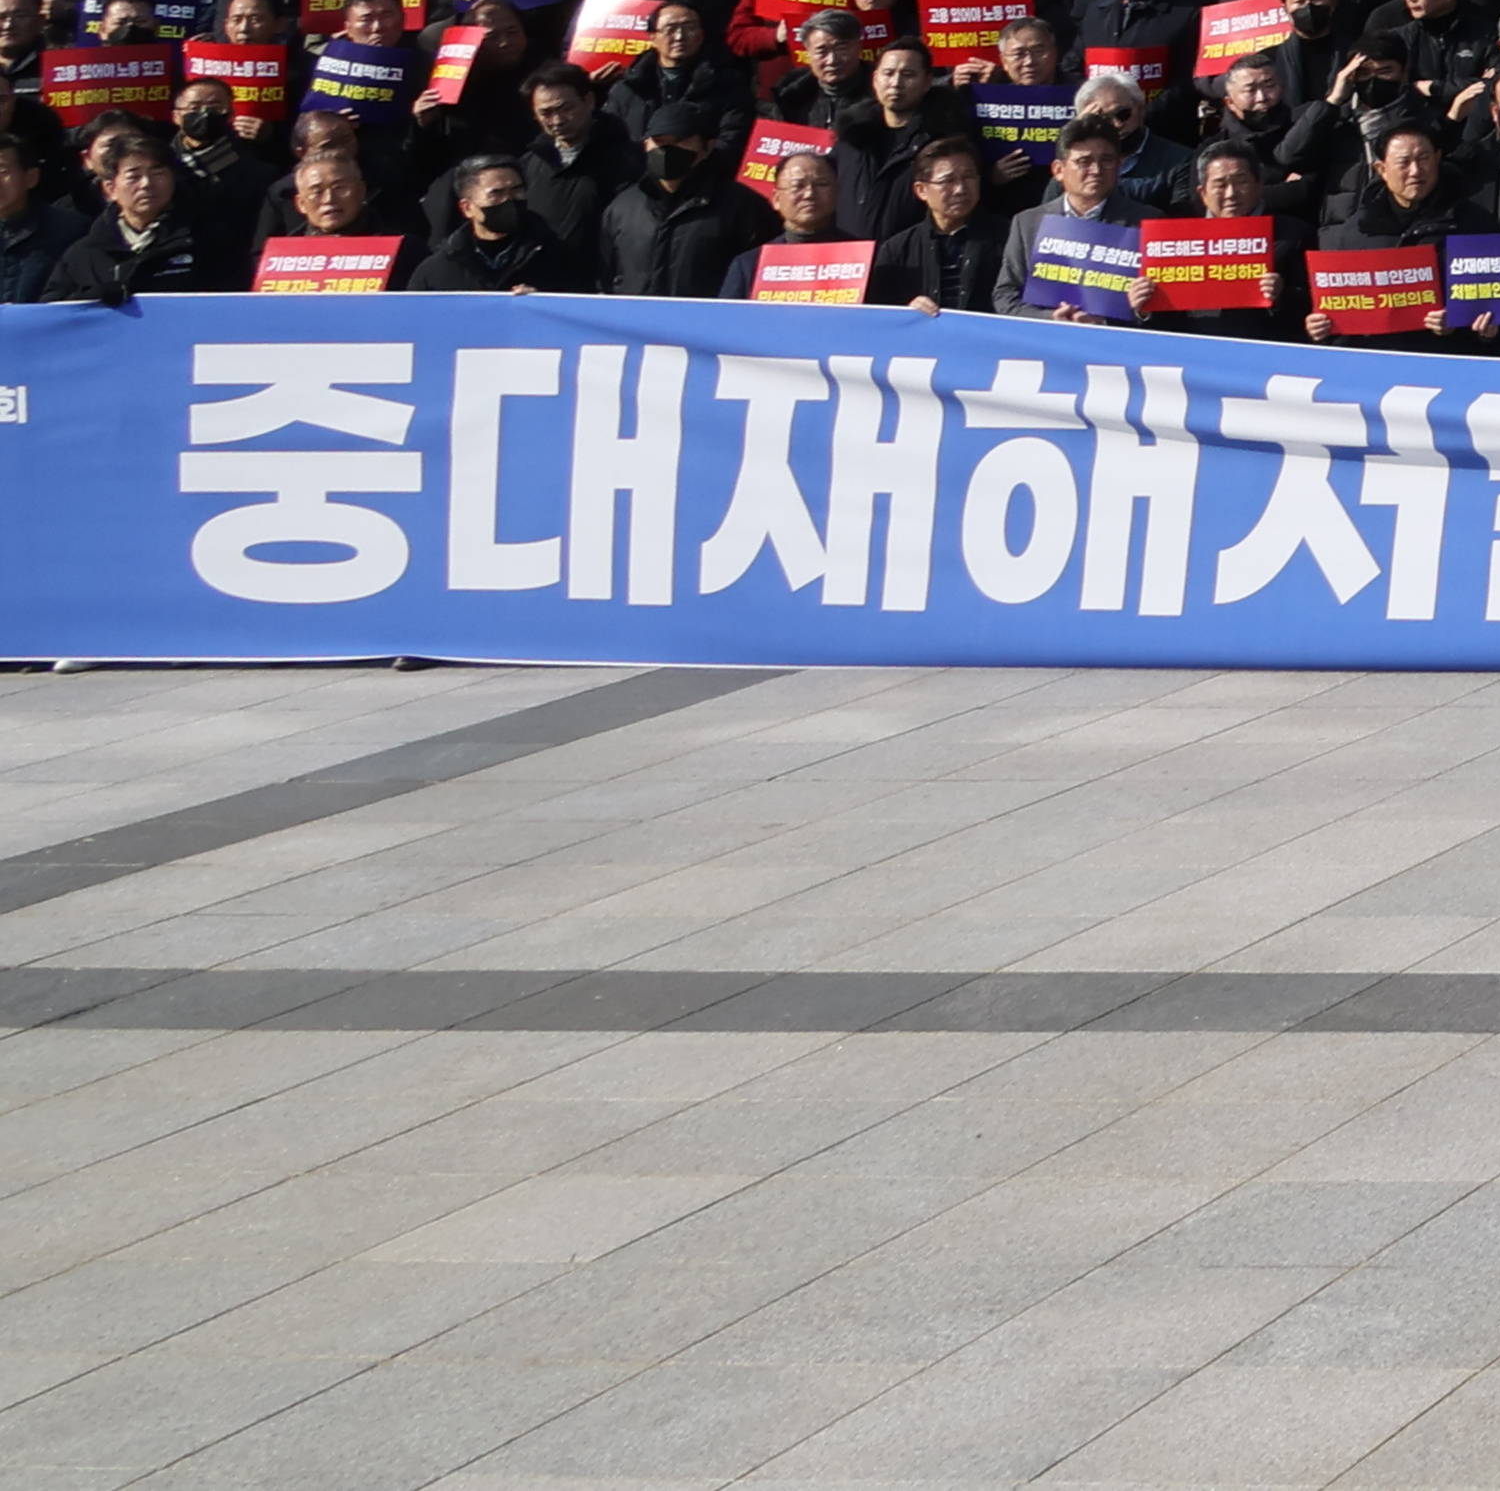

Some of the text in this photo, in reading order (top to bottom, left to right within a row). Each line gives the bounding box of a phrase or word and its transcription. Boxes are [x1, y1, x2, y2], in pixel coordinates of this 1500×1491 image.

[1146, 238, 1267, 257] 해도해도 너무한다
[265, 255, 390, 271] 기업인은 처벌불안
[762, 263, 866, 281] 해도해도 너무한다
[1142, 264, 1270, 285] 민생외면 각성하라
[1315, 267, 1433, 287] 중대재해 불안감에
[1319, 290, 1436, 310] 사라지는 기업의욕
